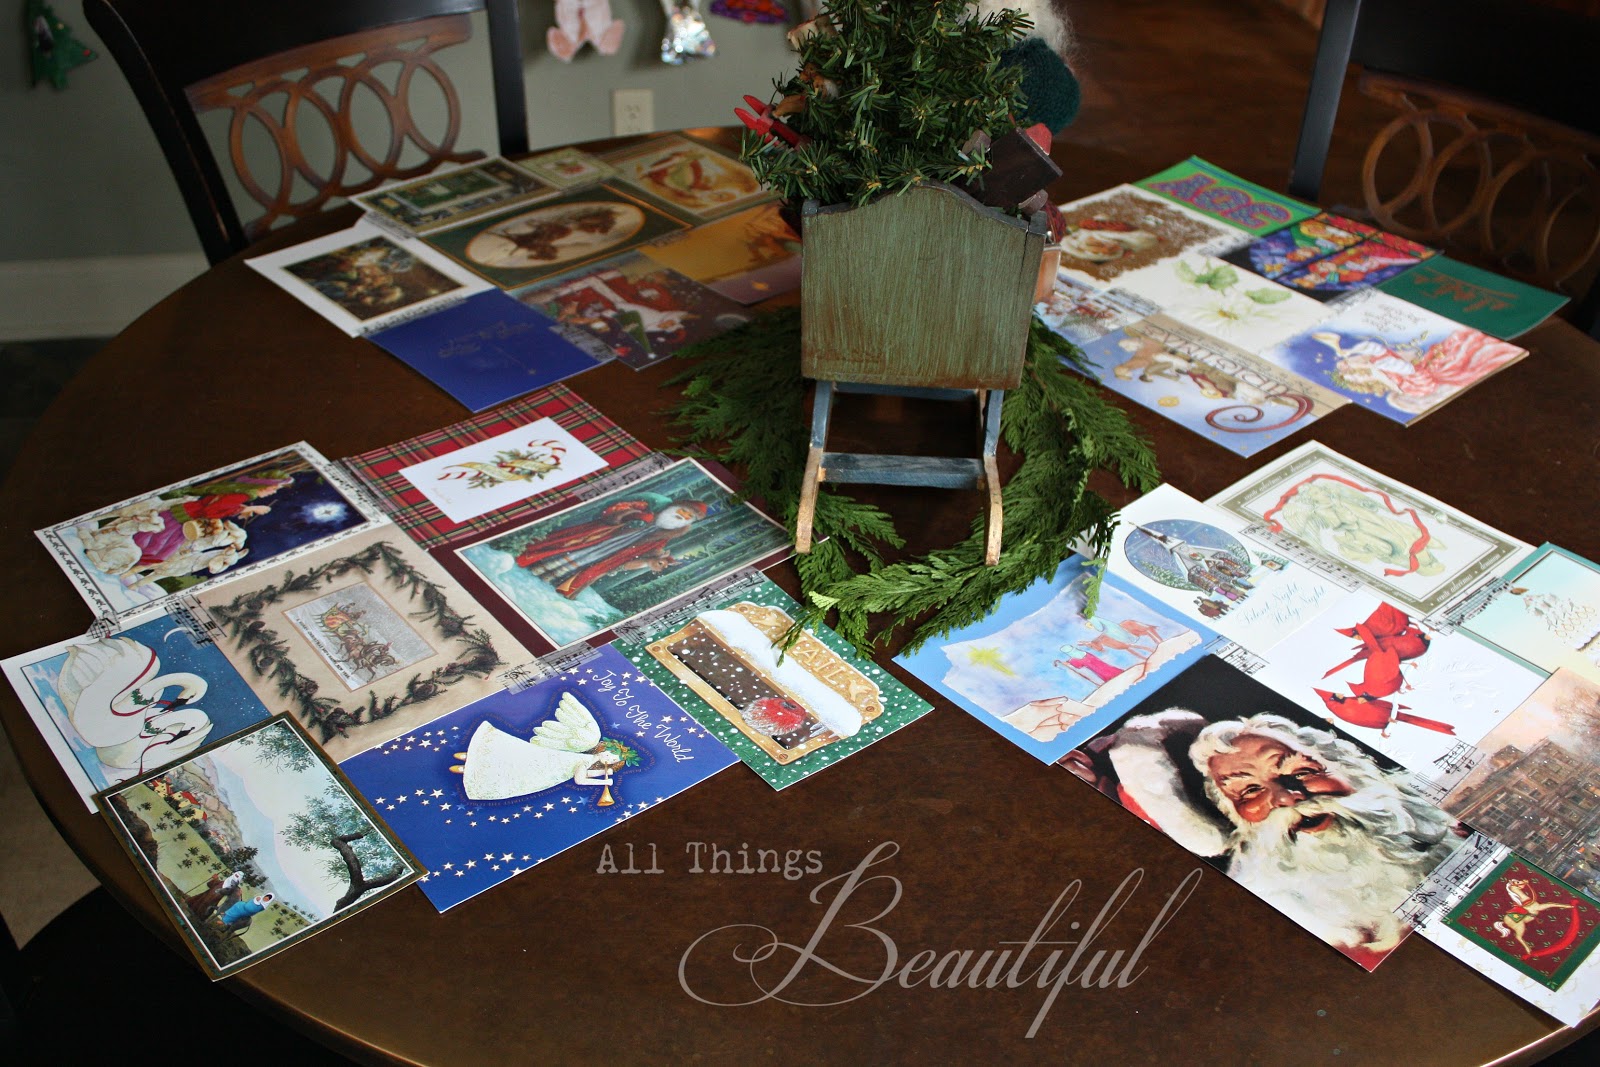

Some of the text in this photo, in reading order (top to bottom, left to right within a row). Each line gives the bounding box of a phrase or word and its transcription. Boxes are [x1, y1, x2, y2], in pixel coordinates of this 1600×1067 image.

[1147, 172, 1293, 230] JOY
[592, 669, 617, 692] Joy
[613, 688, 634, 707] To
[625, 704, 652, 730] The
[654, 724, 694, 763] World
